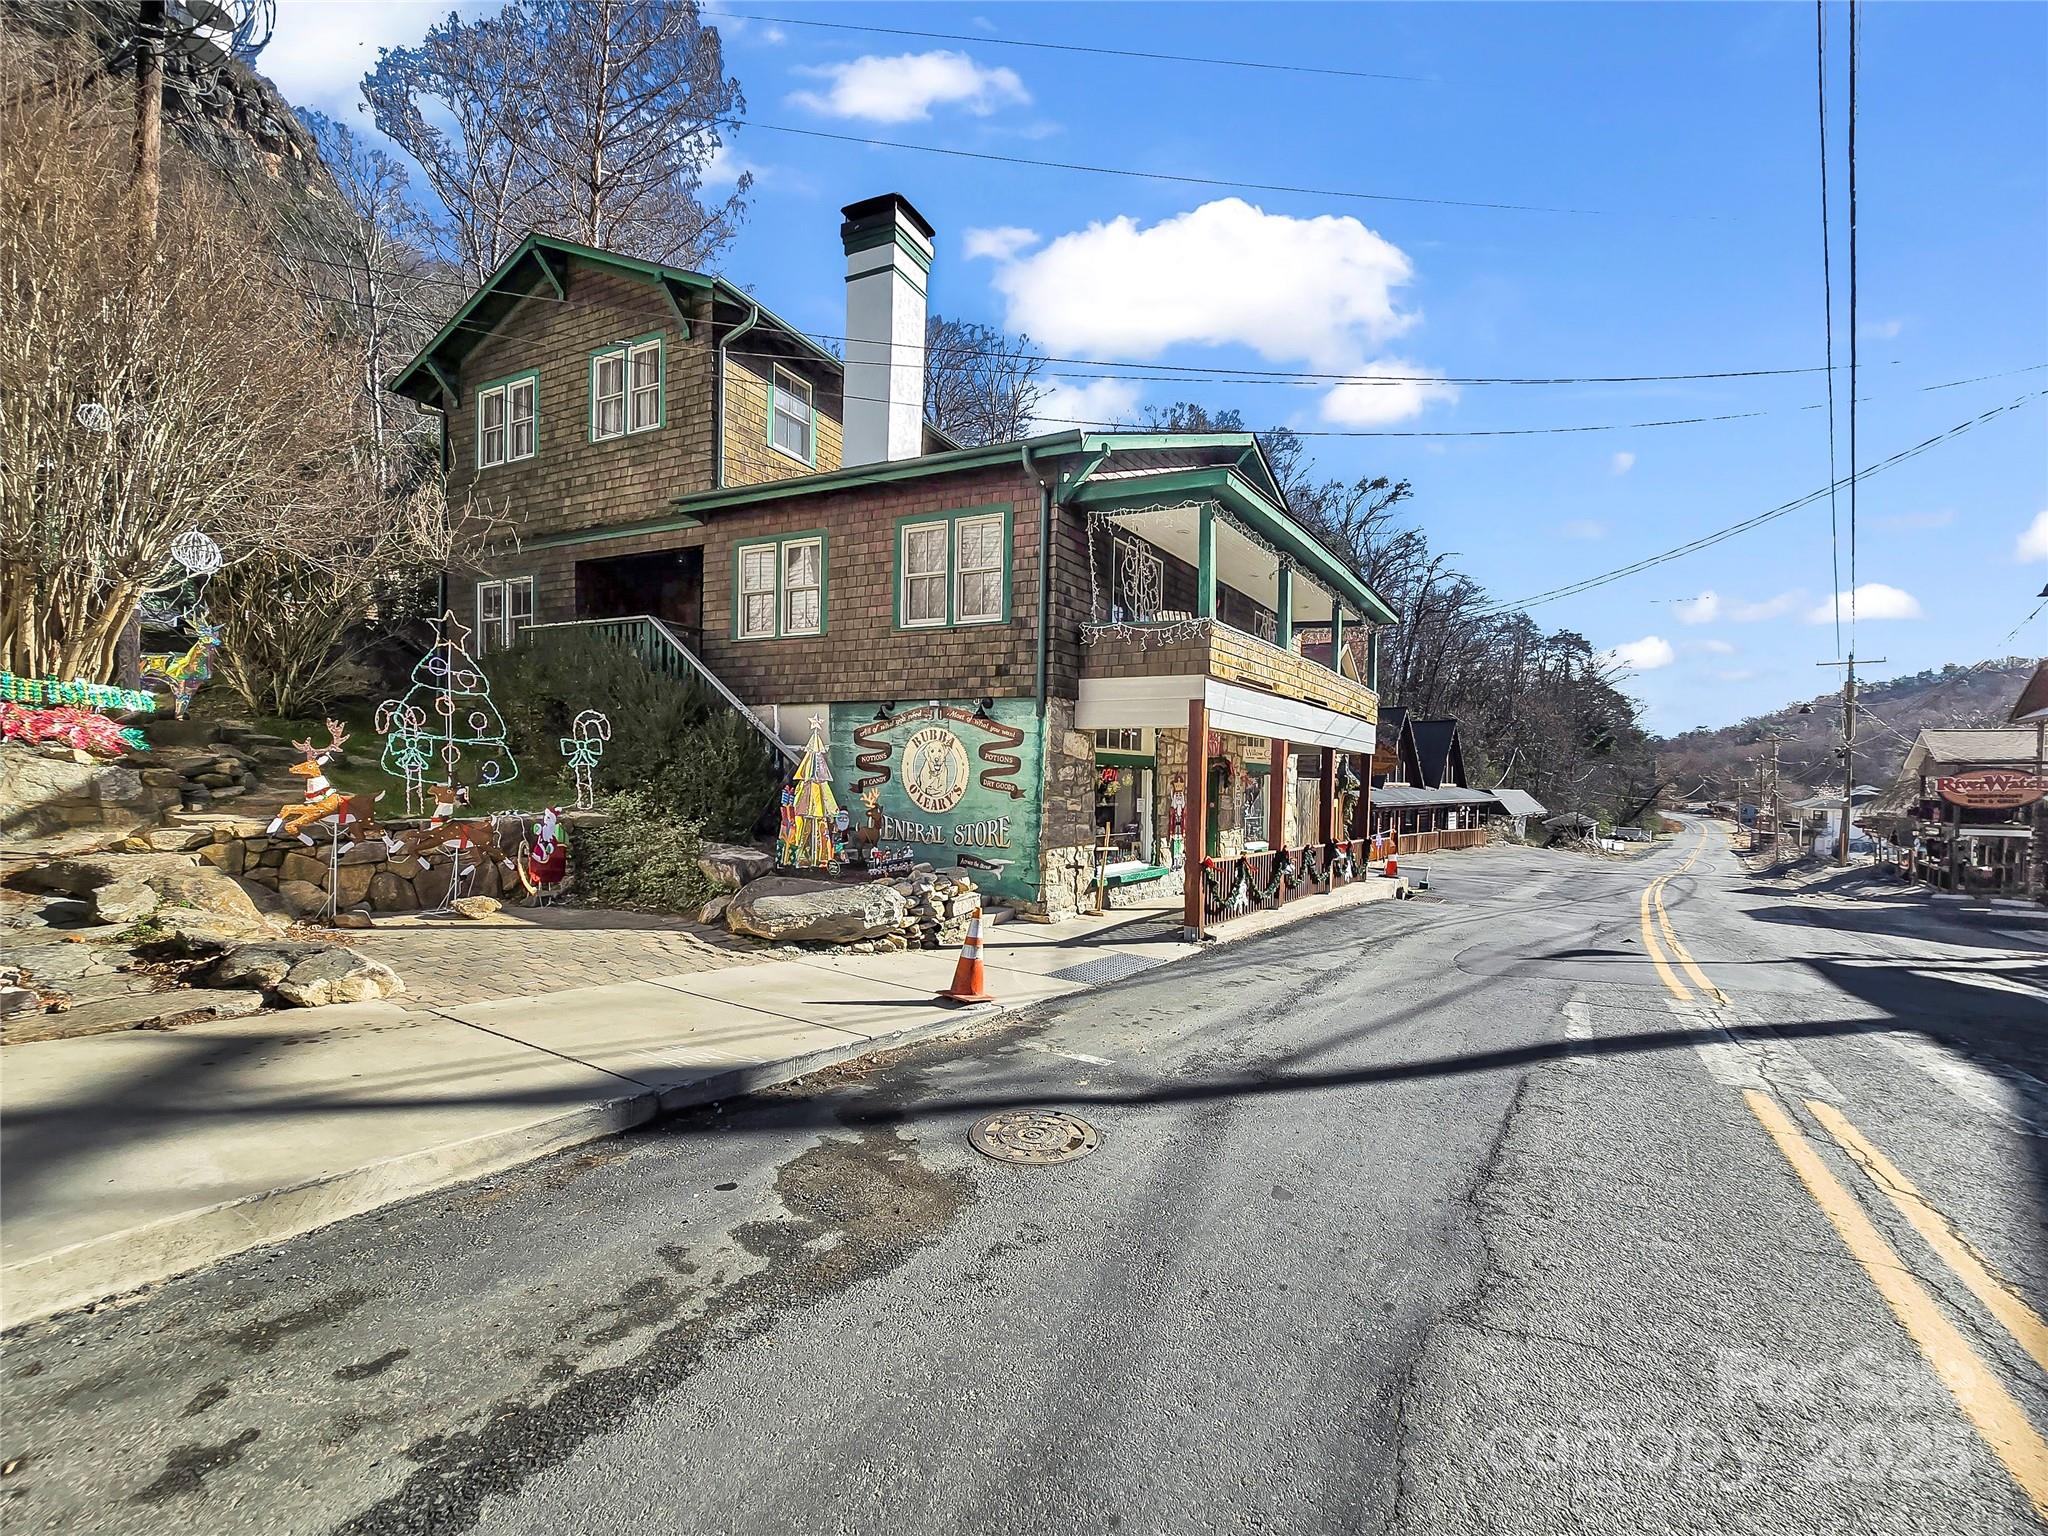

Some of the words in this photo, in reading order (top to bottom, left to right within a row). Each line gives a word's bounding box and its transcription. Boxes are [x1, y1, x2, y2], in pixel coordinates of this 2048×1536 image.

[912, 729, 956, 749] BUBBA
[861, 752, 888, 762] NOTIONS
[984, 753, 1013, 763] POTIONS
[868, 775, 887, 785] CANDY
[983, 779, 995, 788] DRY
[996, 782, 1015, 791] GOODS
[909, 784, 963, 811] O'LEARY'S
[880, 814, 946, 845] ENERAL
[954, 815, 1012, 848] STORE
